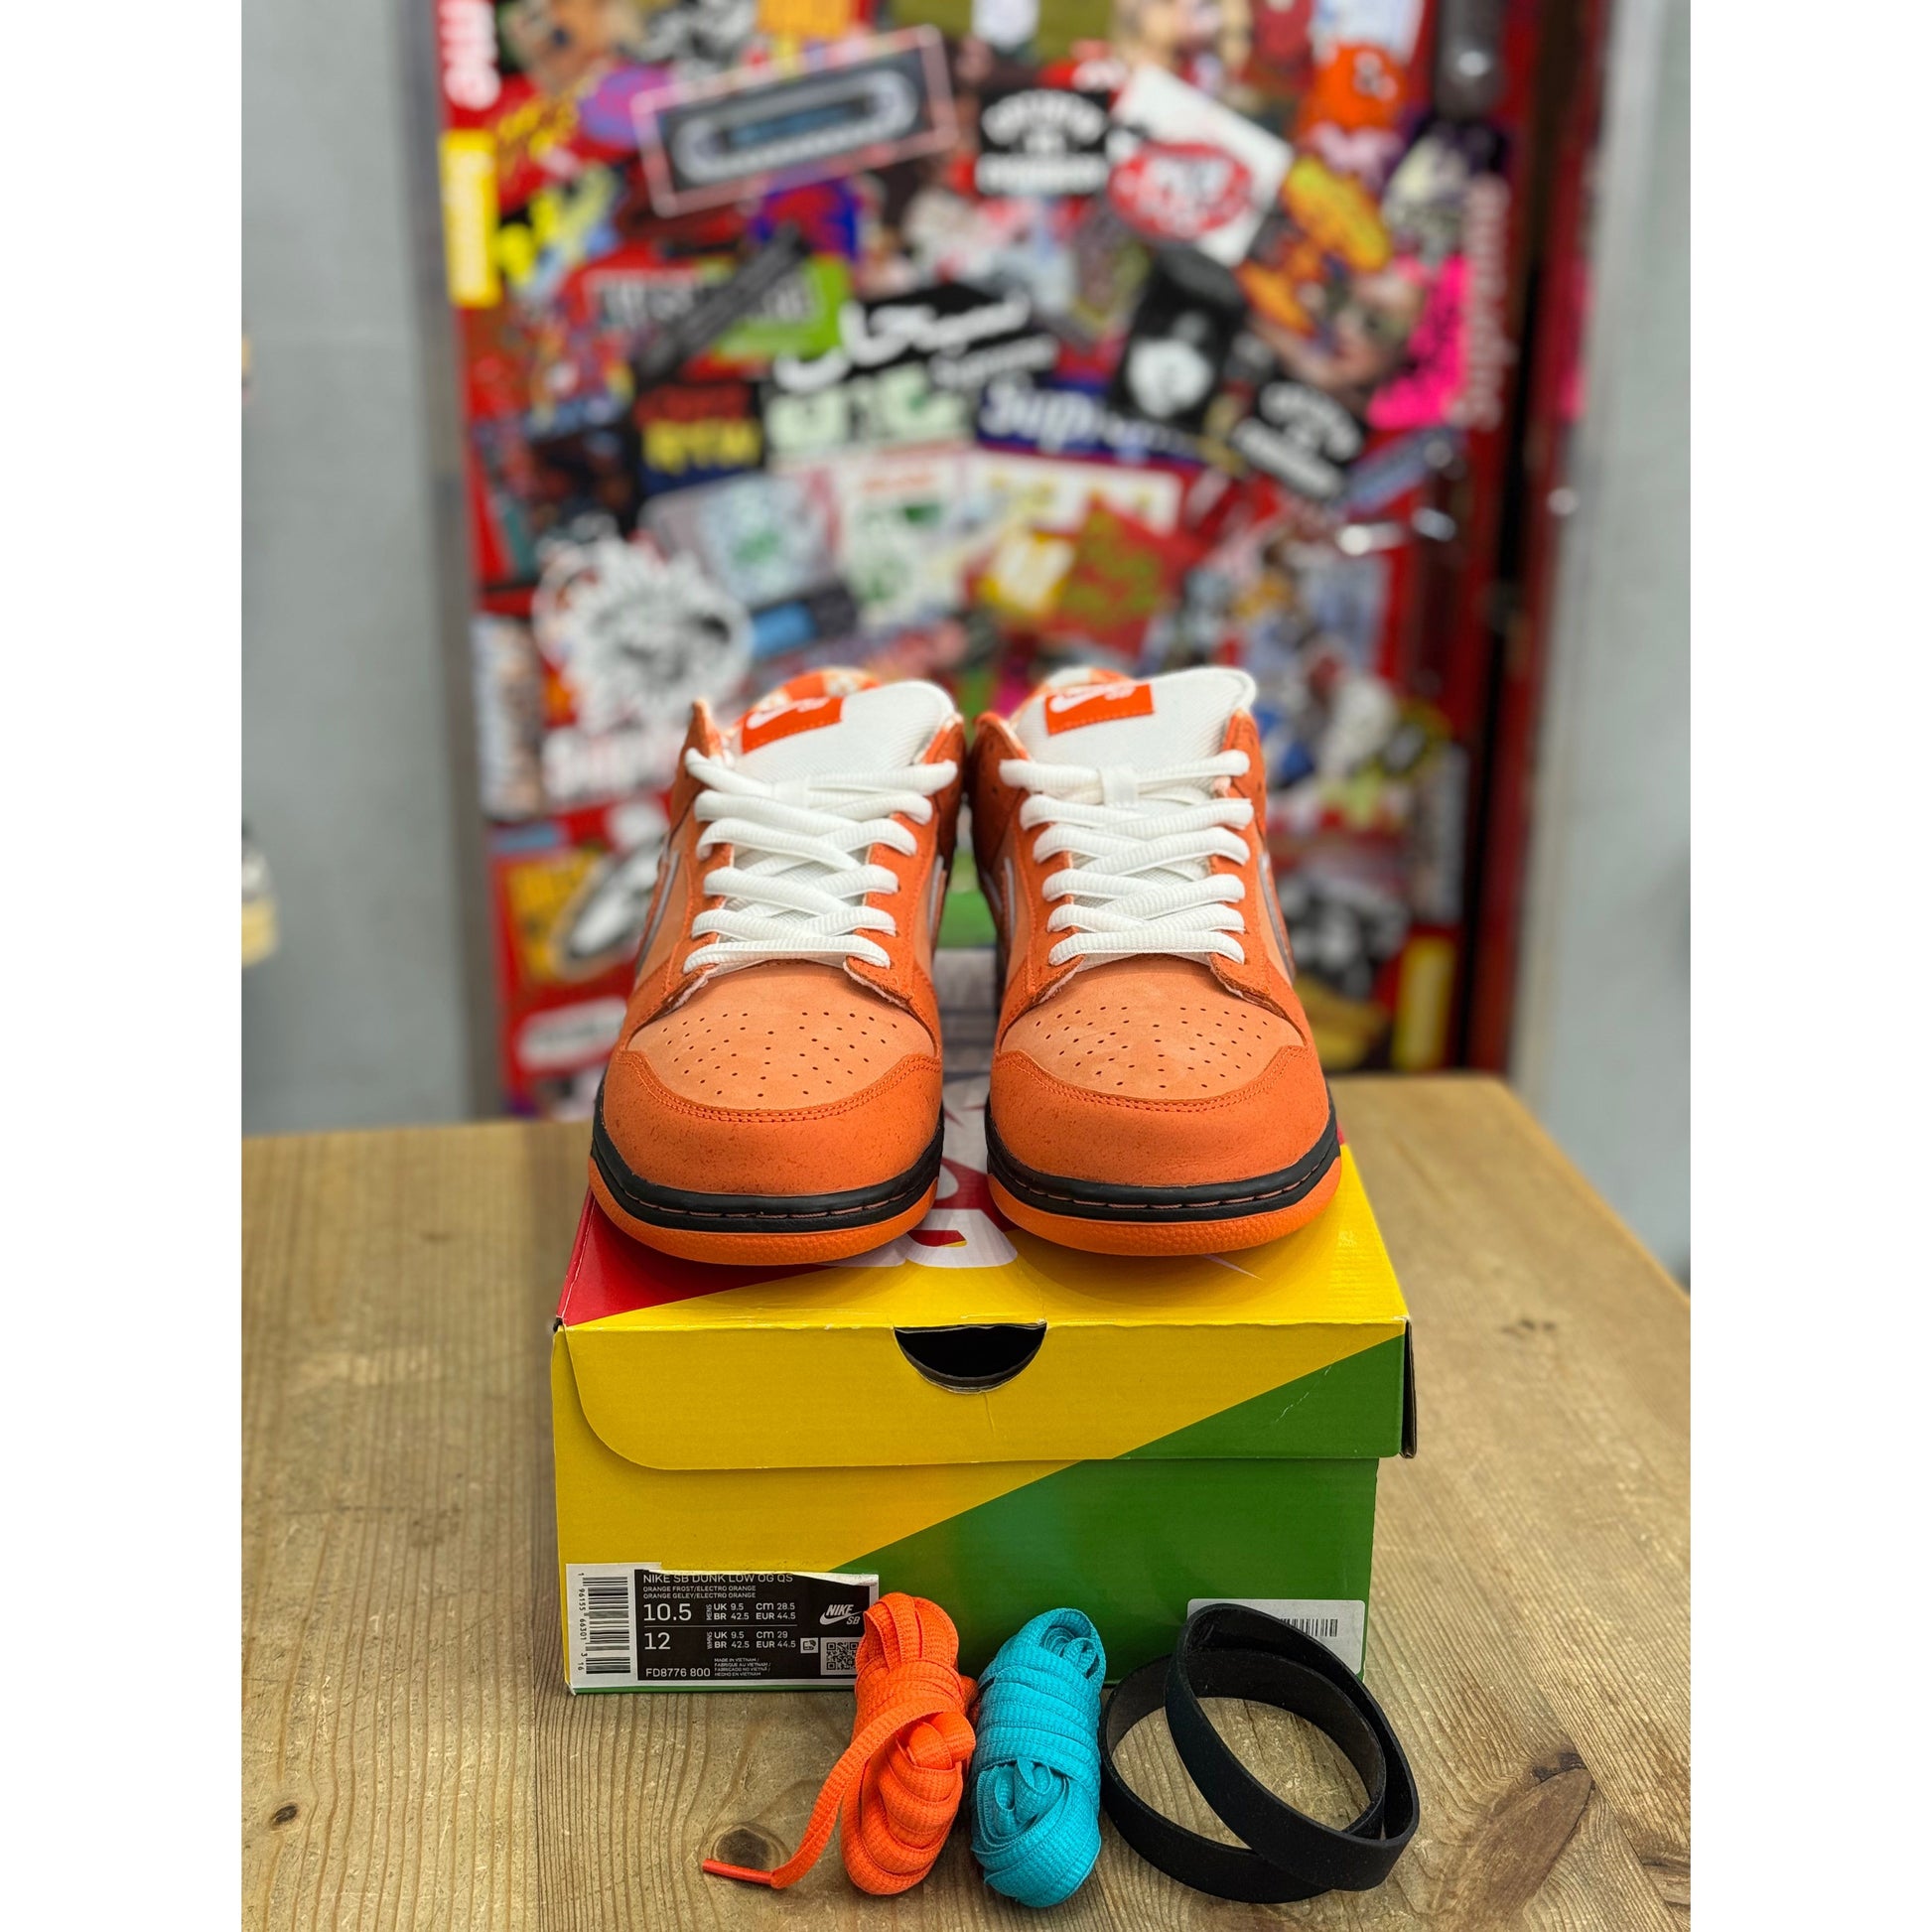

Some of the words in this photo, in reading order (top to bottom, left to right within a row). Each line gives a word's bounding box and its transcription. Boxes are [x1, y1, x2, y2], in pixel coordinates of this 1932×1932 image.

[643, 1575, 670, 1584] NIKE
[644, 1603, 692, 1621] 10.5
[826, 1604, 854, 1616] NIKE
[846, 1616, 861, 1625] SB
[644, 1632, 671, 1649] 12
[646, 1668, 686, 1677] FD8776
[690, 1668, 710, 1677] 800
